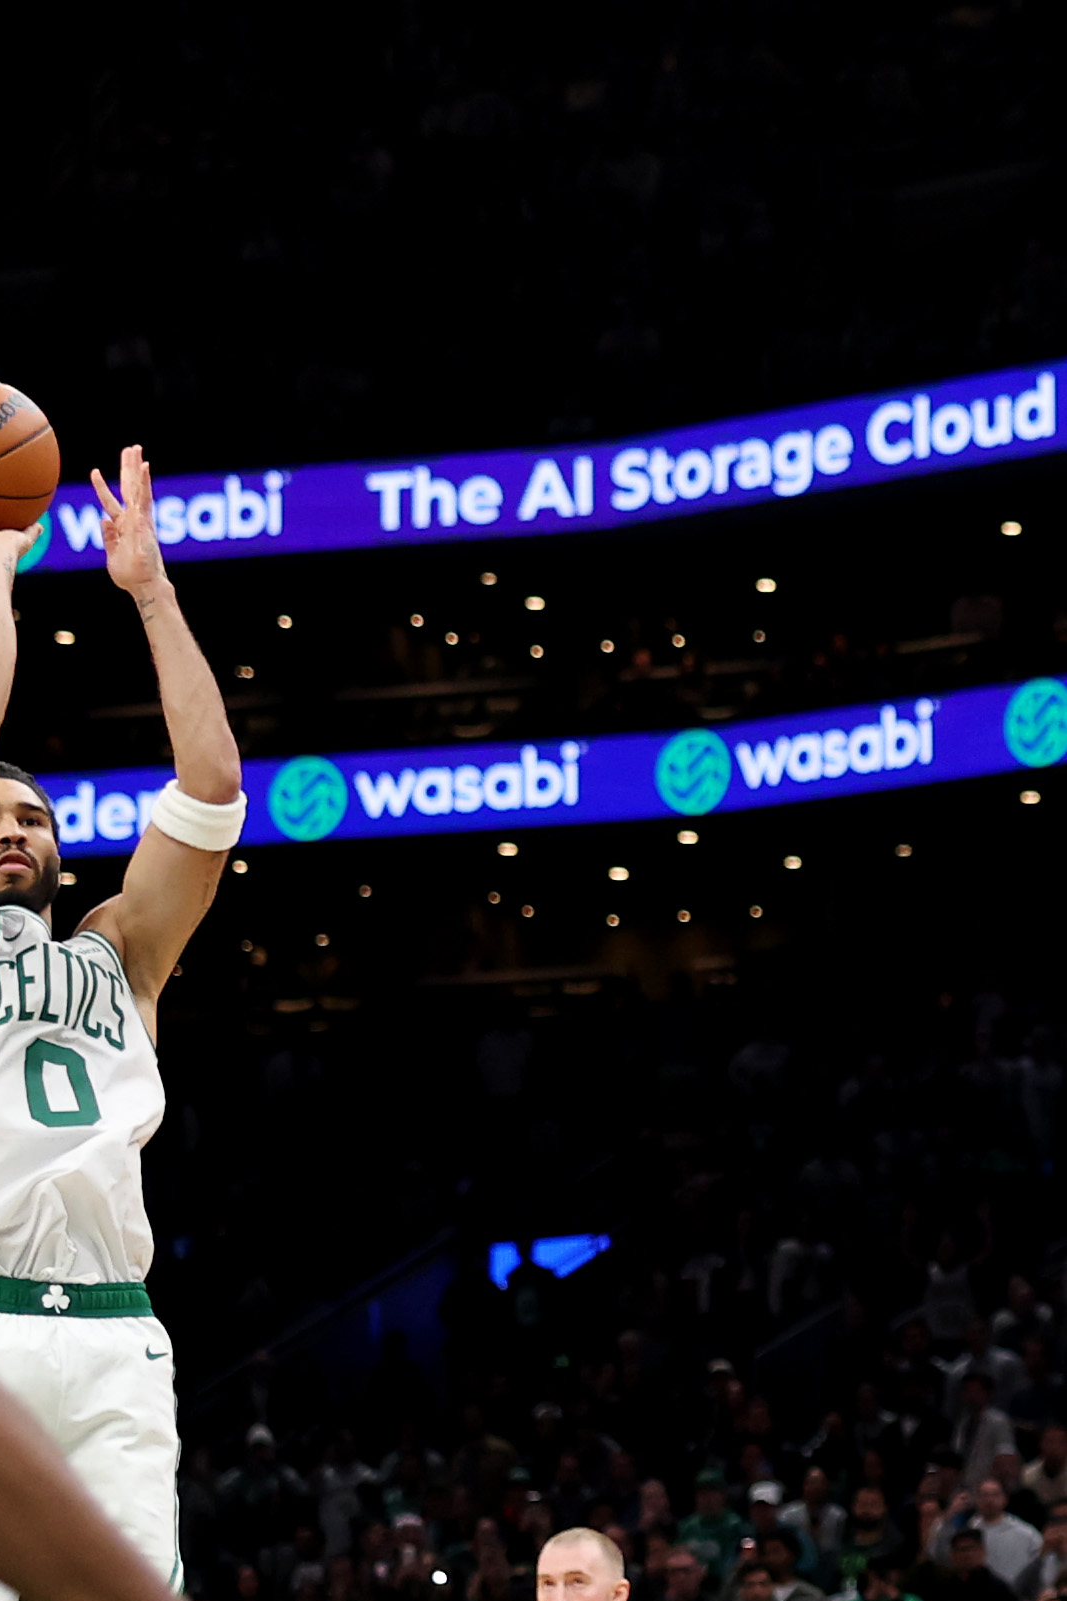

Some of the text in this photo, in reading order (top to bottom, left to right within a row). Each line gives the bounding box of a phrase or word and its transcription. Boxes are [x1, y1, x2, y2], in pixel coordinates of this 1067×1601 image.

[365, 371, 1056, 532] The AI Storage Cloud
[58, 470, 283, 552] wsabi
[354, 741, 580, 819] wasabi
[735, 698, 934, 789] wasabi
[23, 1037, 103, 1129] 0
